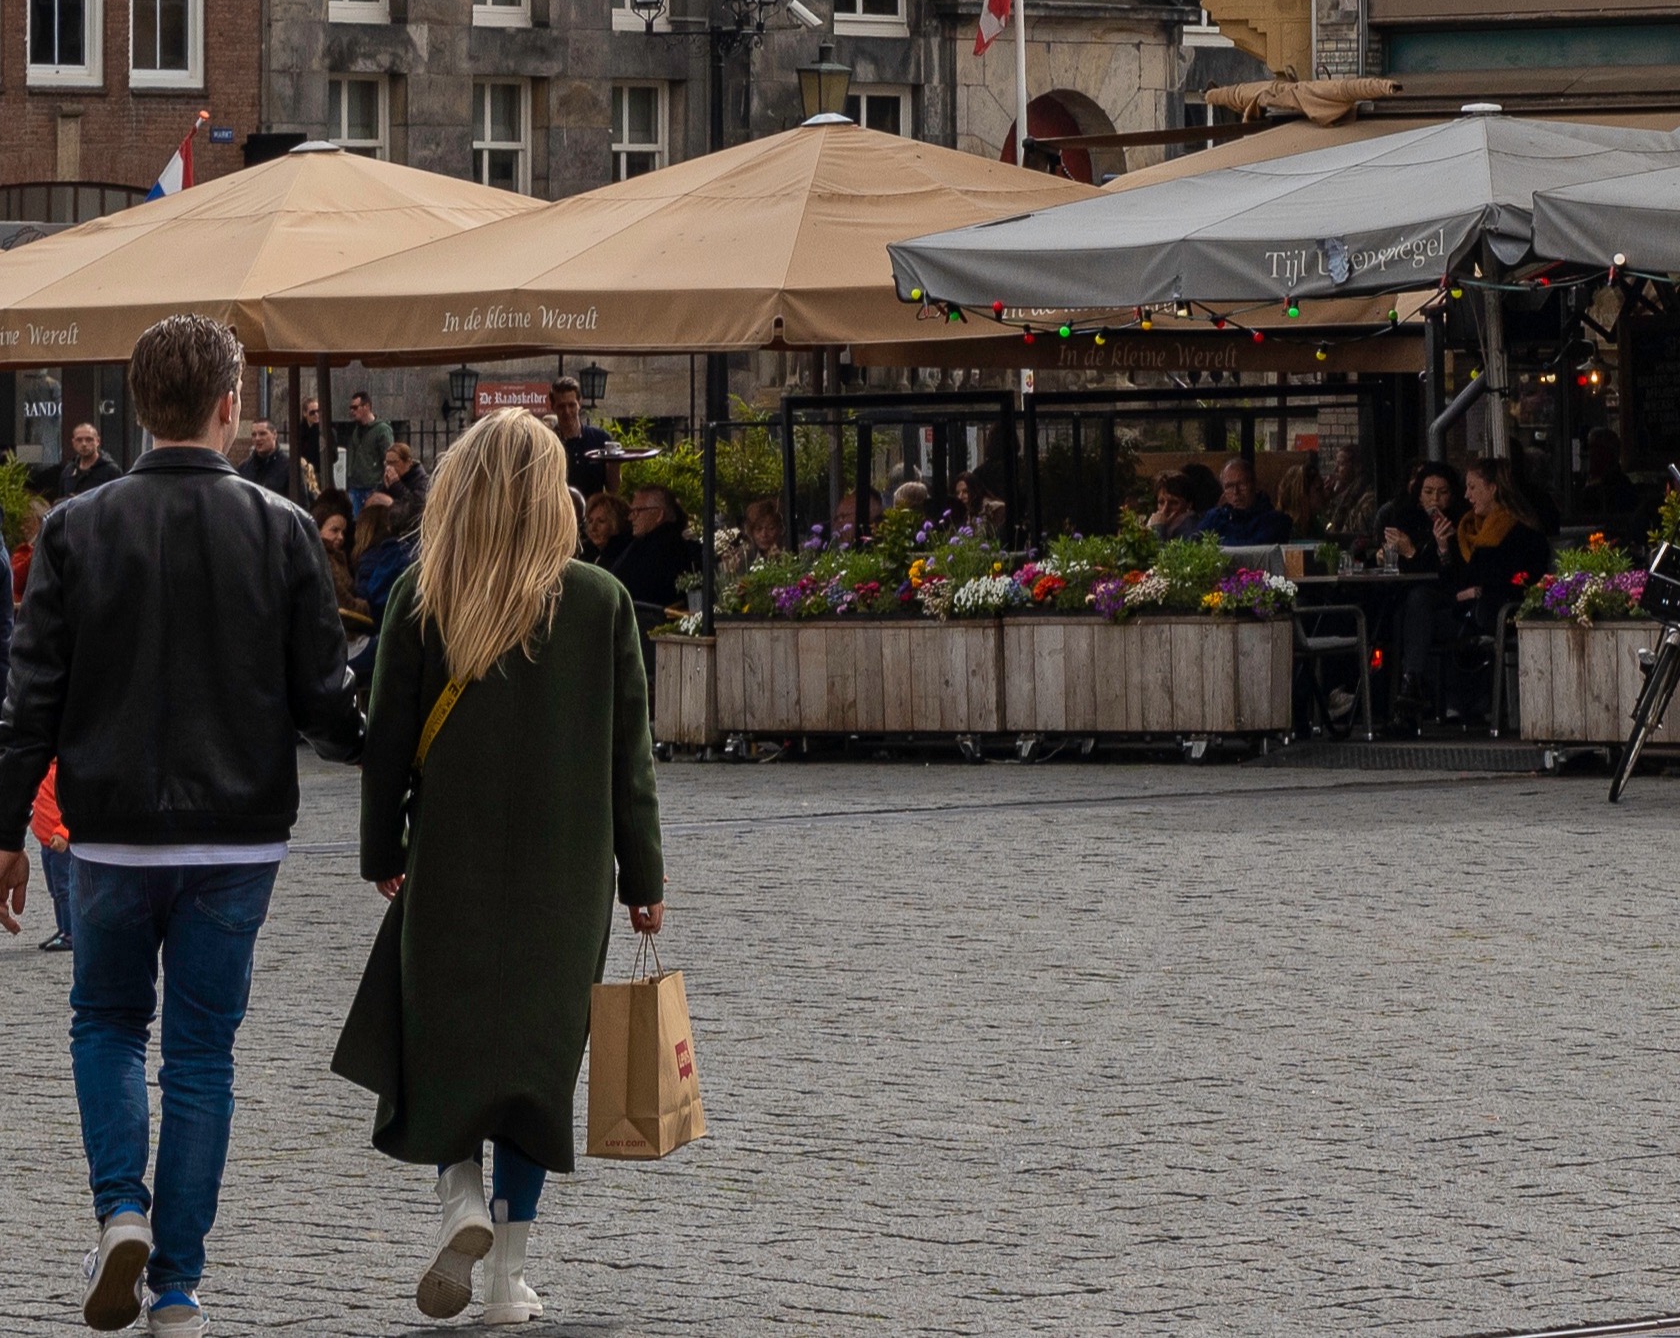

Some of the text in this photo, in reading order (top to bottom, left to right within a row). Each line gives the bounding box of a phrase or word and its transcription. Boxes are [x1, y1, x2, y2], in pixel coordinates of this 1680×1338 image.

[1265, 248, 1308, 287] Tijl
[442, 305, 599, 333] In de kleine Werelt
[26, 322, 80, 346] Werelt
[1058, 341, 1238, 367] In de kleine Werelt
[479, 391, 547, 406] De Raadskelder
[605, 1139, 646, 1148] Levi.com
